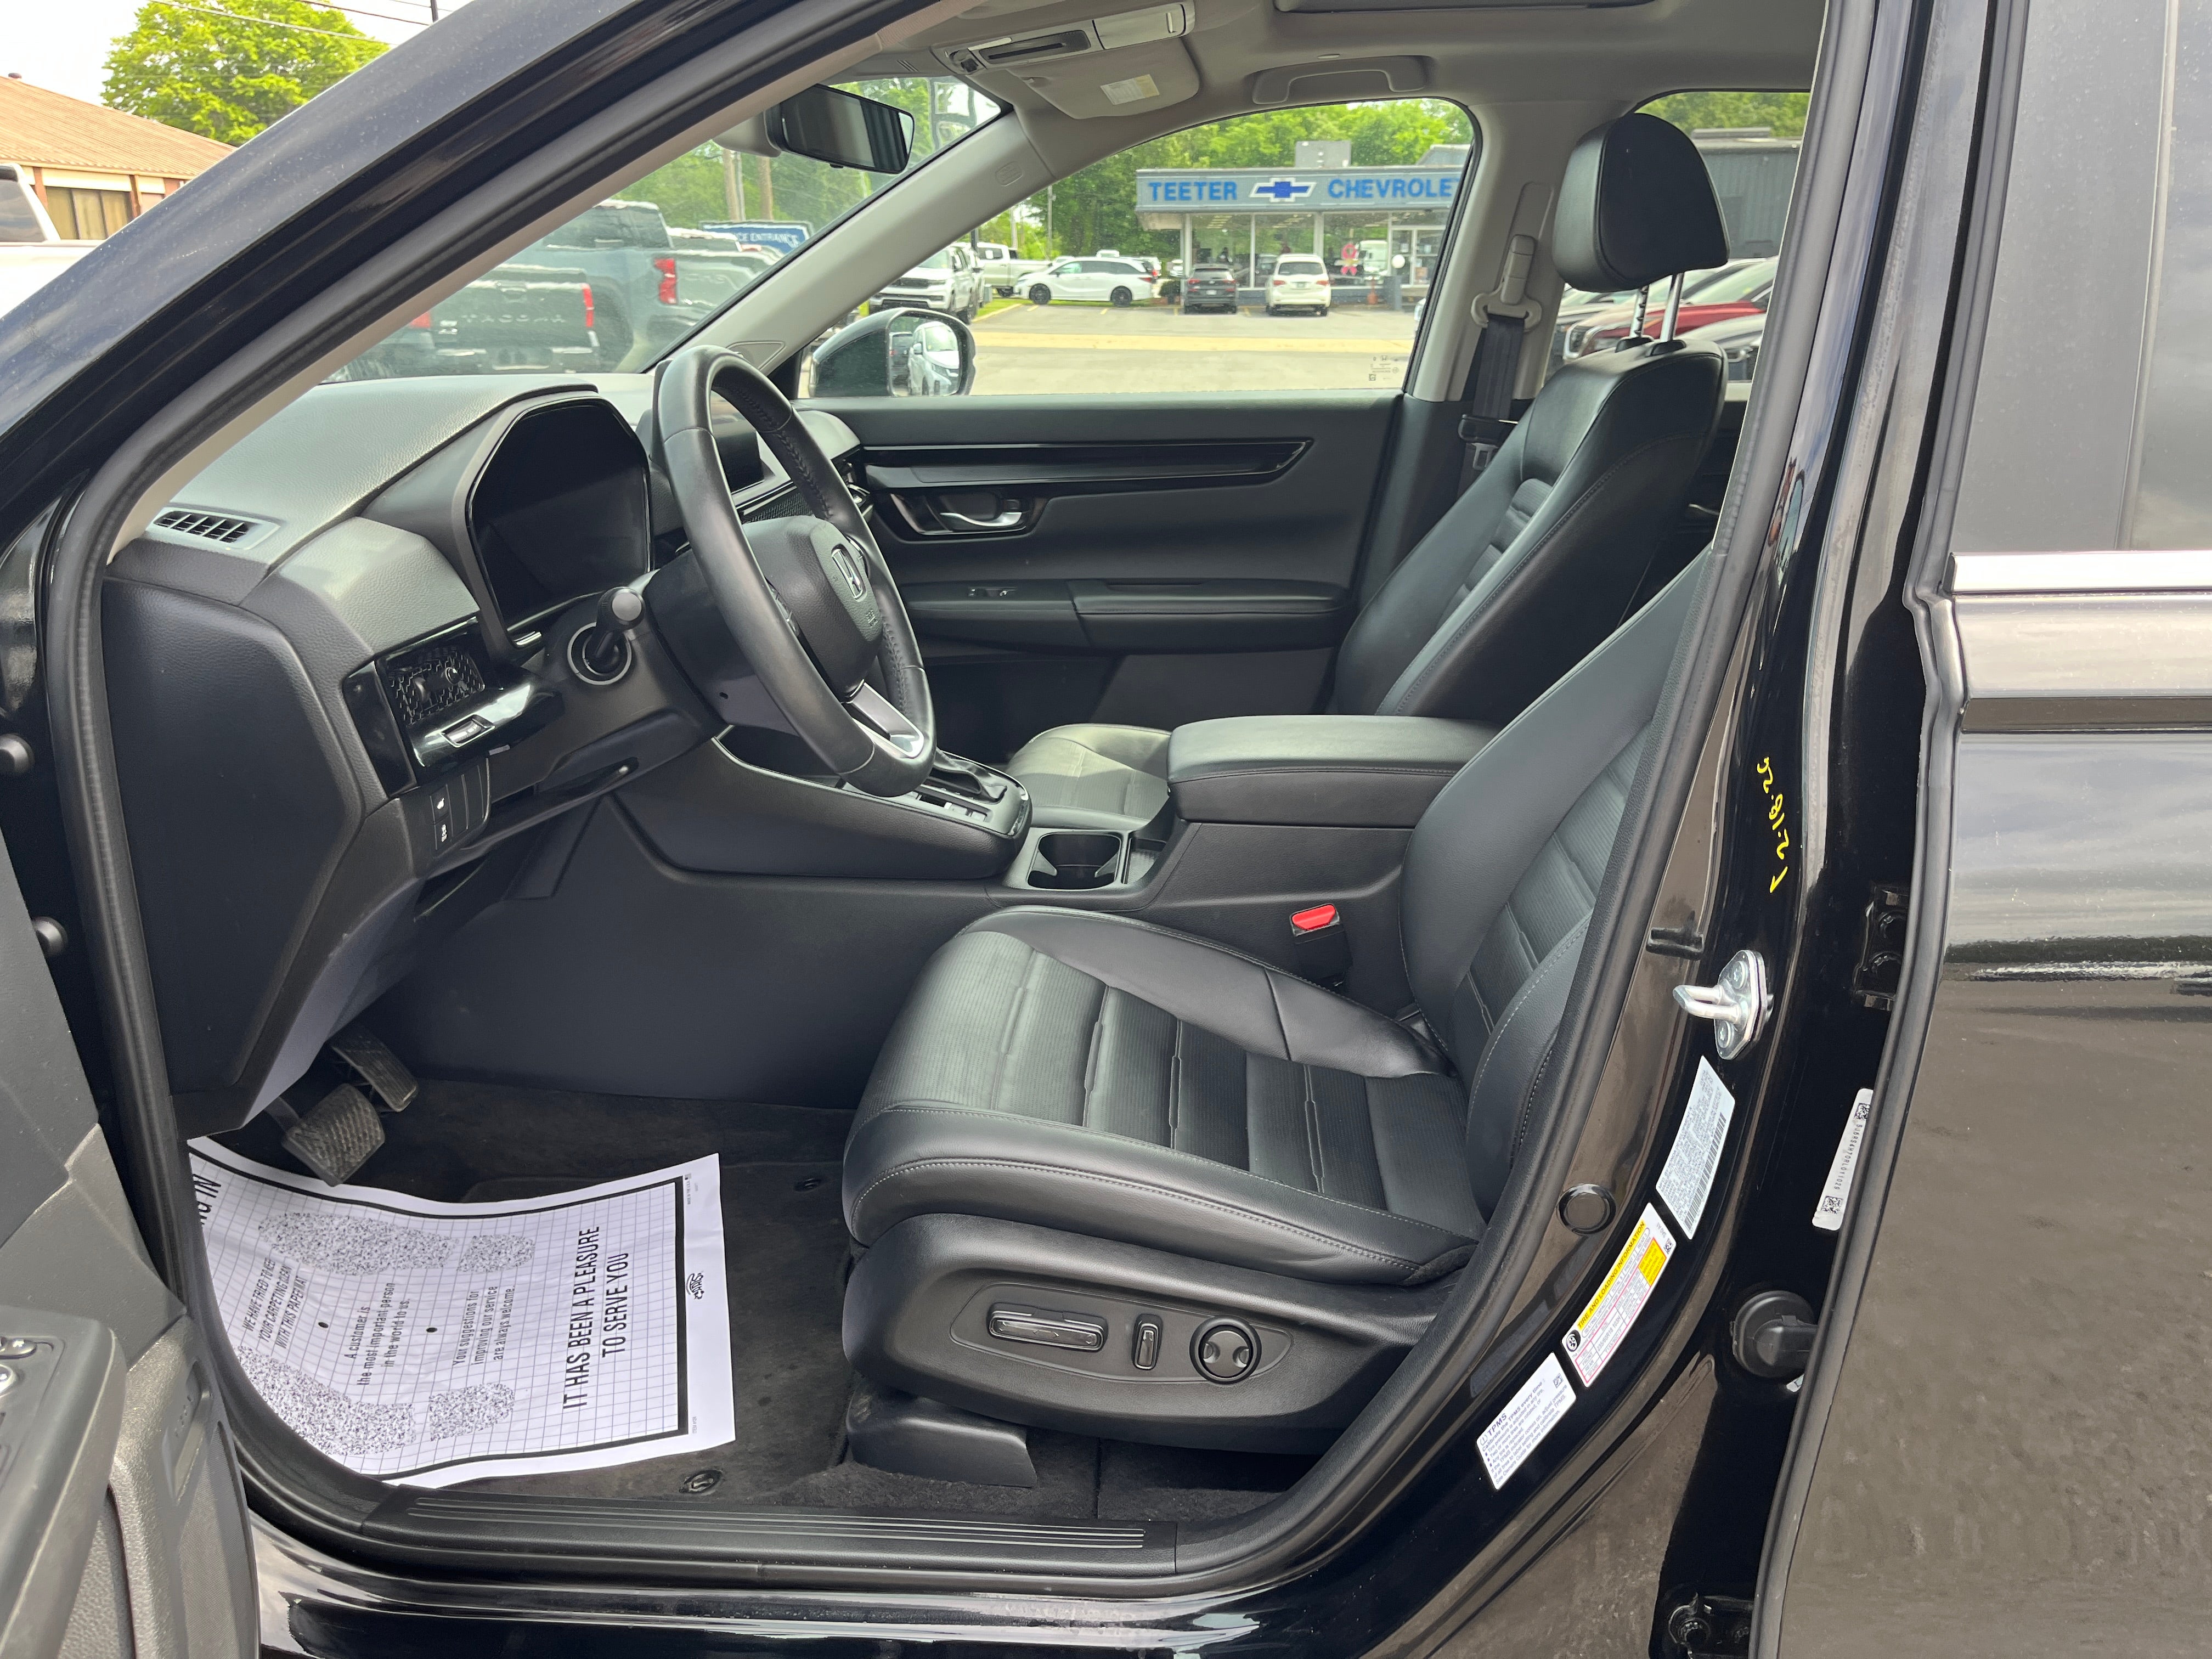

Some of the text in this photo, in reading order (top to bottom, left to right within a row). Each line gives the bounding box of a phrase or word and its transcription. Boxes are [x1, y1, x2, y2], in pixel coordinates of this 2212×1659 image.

[1148, 182, 1238, 201] TEETER
[261, 1269, 273, 1280] TO
[1577, 1311, 1589, 1330] TIRE
[1588, 1296, 1599, 1314] AND
[1598, 1267, 1618, 1299] LOADING
[1617, 1221, 1644, 1269] INFORMATION
[251, 1279, 269, 1300] TRIED
[265, 1282, 288, 1322] CARPETING
[244, 1299, 262, 1319] HAVE
[399, 1299, 410, 1309] us.
[602, 1253, 628, 1357] TO SERVE YOU
[242, 1321, 256, 1332] WE
[281, 1310, 296, 1329] THIS
[452, 1291, 479, 1365] Your suggestions for
[471, 1286, 498, 1365] improving our service
[493, 1285, 515, 1360] are always welcome.
[563, 1227, 599, 1409] IT HAS BEEN A PLEASURE
[258, 1320, 275, 1342] YOUR
[275, 1328, 290, 1349] WITH
[348, 1316, 368, 1351] customer
[357, 1283, 395, 1385] the most important person
[390, 1321, 404, 1342] world
[383, 1345, 398, 1357] the
[1482, 1429, 1500, 1452] Calibrate
[1508, 1406, 1521, 1422] TPMS
[1520, 1392, 1533, 1408] every
[1487, 1412, 1507, 1437] TPMS
[1494, 1427, 1510, 1447] pressure
[1512, 1407, 1527, 1426] adjusted
